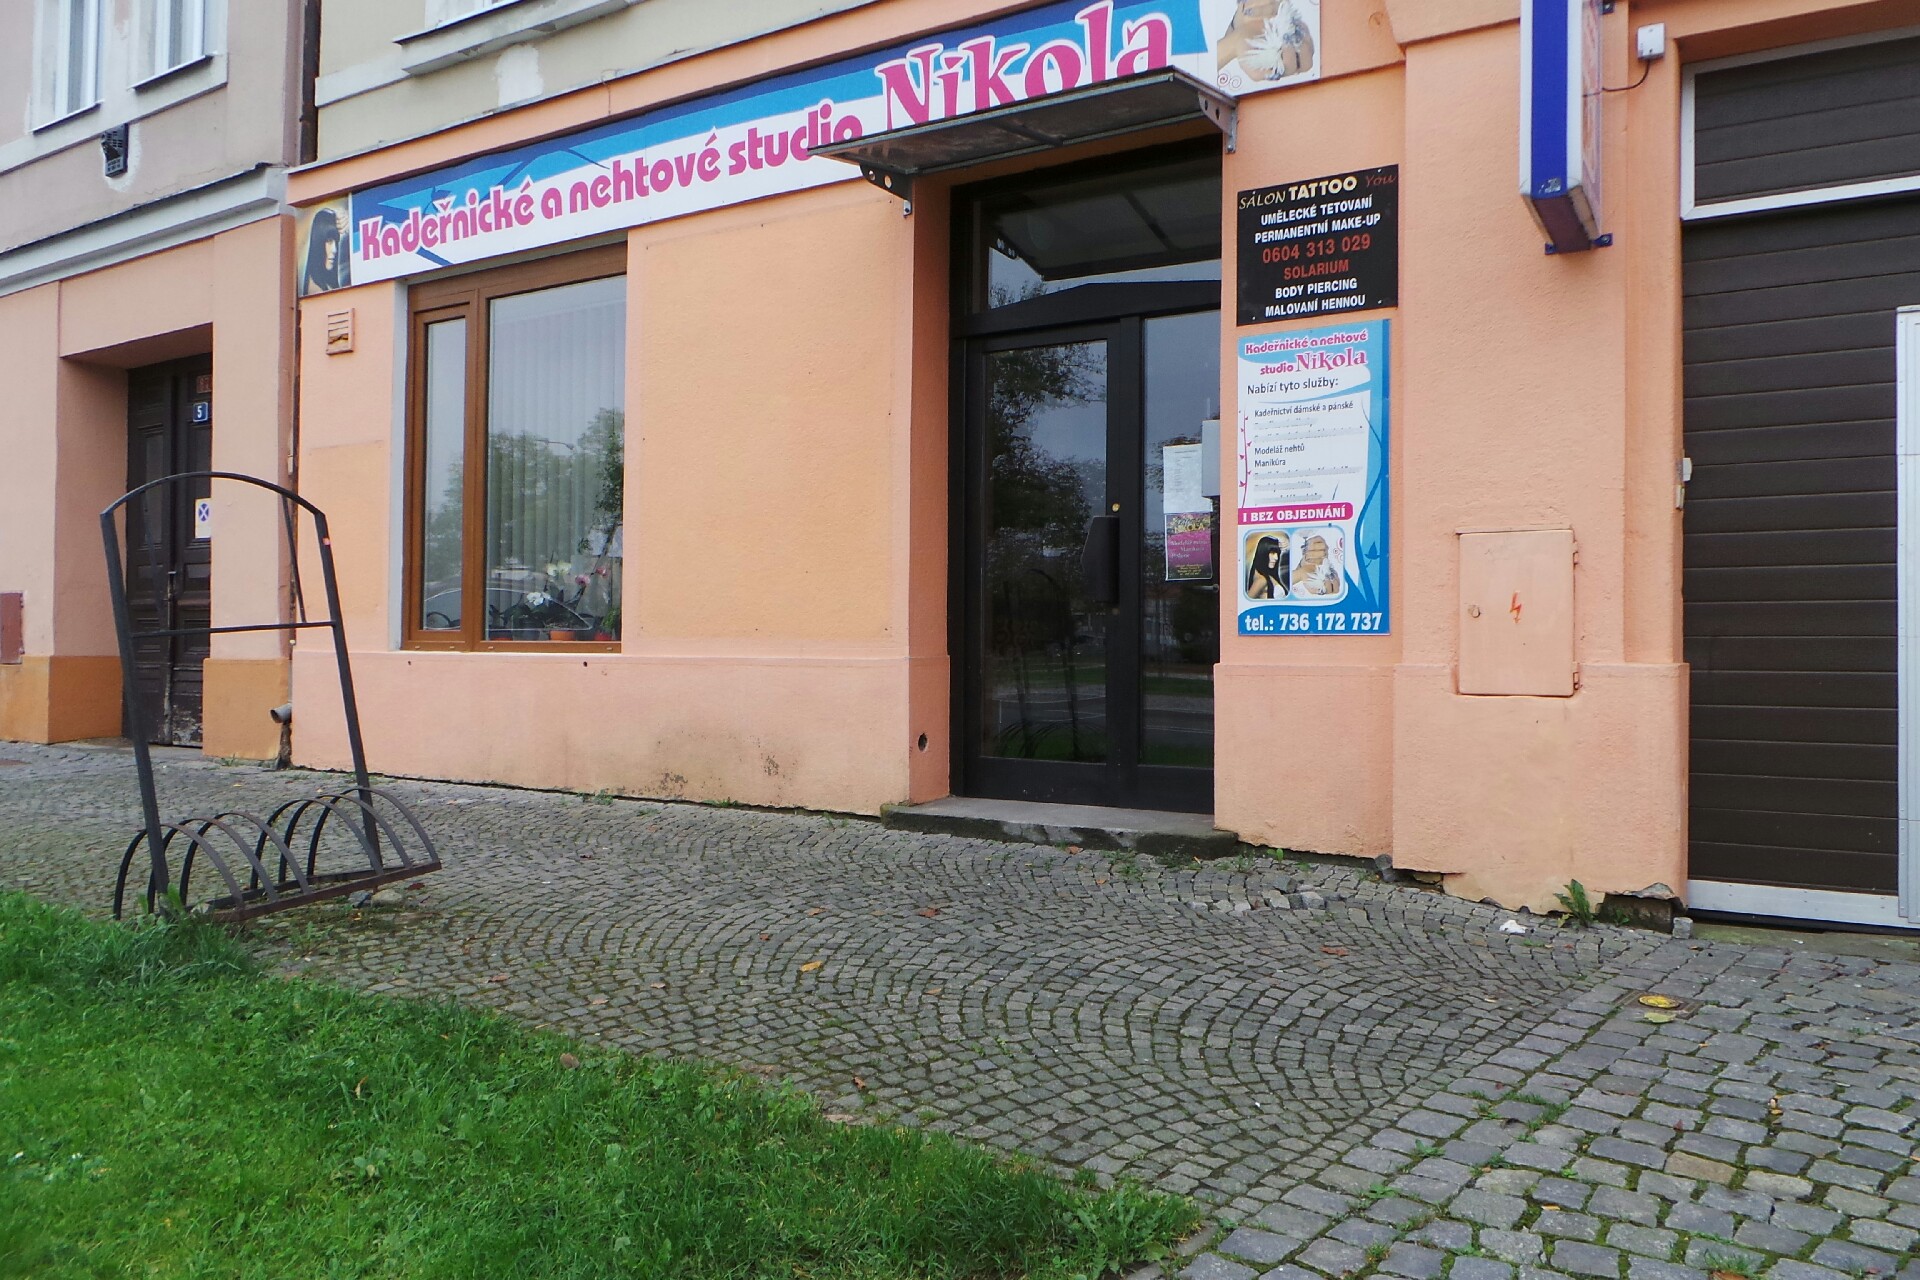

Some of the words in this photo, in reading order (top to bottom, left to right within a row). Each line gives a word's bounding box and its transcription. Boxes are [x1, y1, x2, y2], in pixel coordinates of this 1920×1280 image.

[362, 180, 535, 261] Kadeřnické
[541, 187, 562, 219] a
[569, 132, 721, 213] nehtové
[728, 103, 863, 176] studio
[878, 5, 1168, 131] Nikola
[1288, 175, 1358, 201] TATTOO
[1365, 174, 1397, 188] You
[1260, 203, 1317, 226] UMĚLECKÉ
[1254, 219, 1329, 244] PERMANENTNÍ
[1331, 212, 1381, 232] MAKE-UP
[1262, 244, 1300, 264] 0604
[1306, 238, 1335, 258] 313
[1341, 233, 1371, 252] 029
[1284, 259, 1349, 280] SOLARIUM
[1275, 284, 1304, 299] BODY
[1307, 277, 1358, 295] PIERCING
[1321, 294, 1366, 311] HENNOU
[1245, 338, 1309, 354] Kadeřnické
[1310, 338, 1318, 346] a
[1319, 330, 1367, 346] nehtové
[1260, 362, 1294, 375] studio
[1296, 347, 1367, 372] Nikola
[1247, 381, 1277, 395] Nabízí
[1279, 383, 1300, 394] tyto
[1302, 376, 1339, 390] služby:
[197, 405, 203, 419] 5
[1254, 405, 1293, 418] Kadeřnictví
[1293, 403, 1321, 414] dámské
[1328, 400, 1354, 412] pánské
[1254, 444, 1283, 455] Modeláž
[1284, 442, 1305, 454] nehtů
[1242, 513, 1247, 522] I
[1250, 511, 1274, 522] BEZ
[1276, 504, 1346, 521] OBJEDNÁNÍ
[1244, 614, 1274, 631] tel.:
[1279, 613, 1310, 631] 736
[1315, 612, 1346, 631] 172
[1350, 612, 1383, 631] 737
